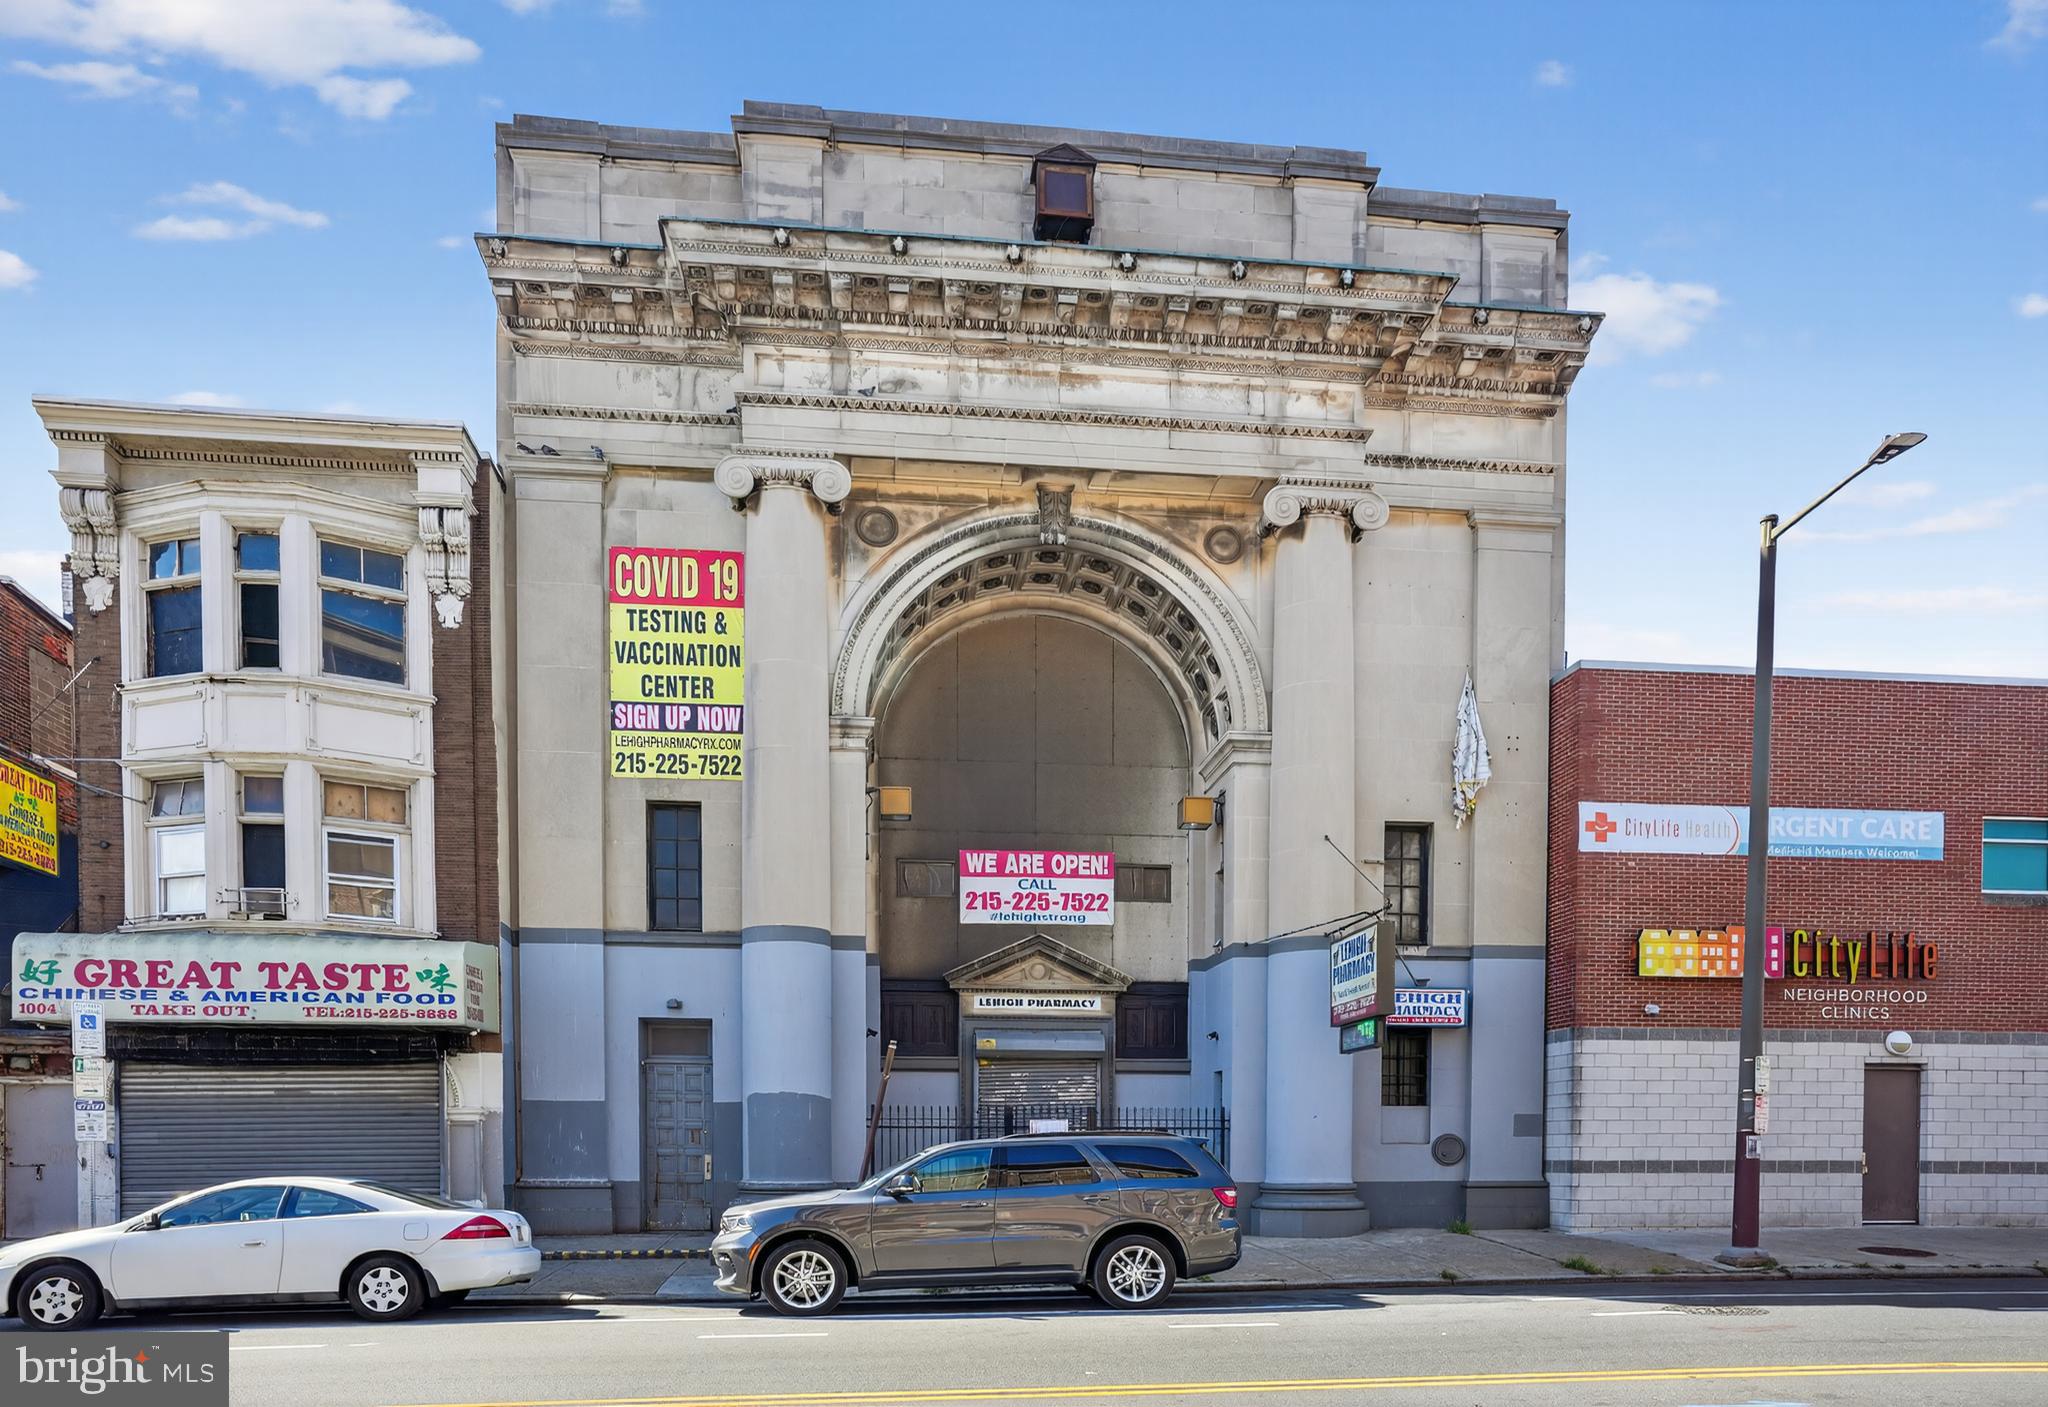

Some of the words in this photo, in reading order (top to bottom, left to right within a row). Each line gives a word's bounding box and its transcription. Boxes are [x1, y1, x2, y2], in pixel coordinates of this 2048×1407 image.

[615, 553, 699, 599] COVID
[708, 558, 739, 601] 19
[626, 608, 706, 634] TESTING
[714, 612, 727, 635] &
[615, 641, 741, 667] VACCINATION
[641, 674, 714, 699] CENTER
[614, 703, 660, 729] SIGN
[665, 705, 691, 730] UP
[697, 706, 742, 732] NOW
[615, 735, 742, 750] LEHIGHPHARMACYRX.COM
[615, 752, 742, 776] 215-225-7522
[1625, 818, 1680, 839] CityLife
[1685, 820, 1731, 838] Health
[1770, 815, 1853, 839] RGENT
[1860, 817, 1932, 841] CARE
[965, 853, 998, 873] WE
[1004, 853, 1044, 874] ARE
[1051, 854, 1109, 875] OPEN!
[1018, 879, 1057, 890] CALL
[965, 891, 1109, 912] 215-225-7522
[1793, 929, 1938, 984] CityLife
[19, 959, 62, 985] 好
[74, 959, 242, 989] GREAT
[258, 962, 410, 992] TASTE
[415, 963, 457, 993] 味
[1333, 952, 1375, 986] PHARMACY
[19, 988, 158, 1000] CHINESE
[169, 990, 189, 1001] &
[201, 990, 365, 1004] AMERICAN
[376, 993, 457, 1005] FOOD
[979, 998, 1023, 1007] LEHIGH
[1027, 999, 1095, 1008] PHARMACY
[1395, 993, 1461, 1004] EHIGH
[1784, 988, 1927, 1003] NEIGHBORHOOD
[19, 1003, 57, 1015] 1004
[130, 1005, 196, 1016] TAKE
[202, 1006, 250, 1016] OUT
[1821, 1005, 1890, 1020] CLINICS
